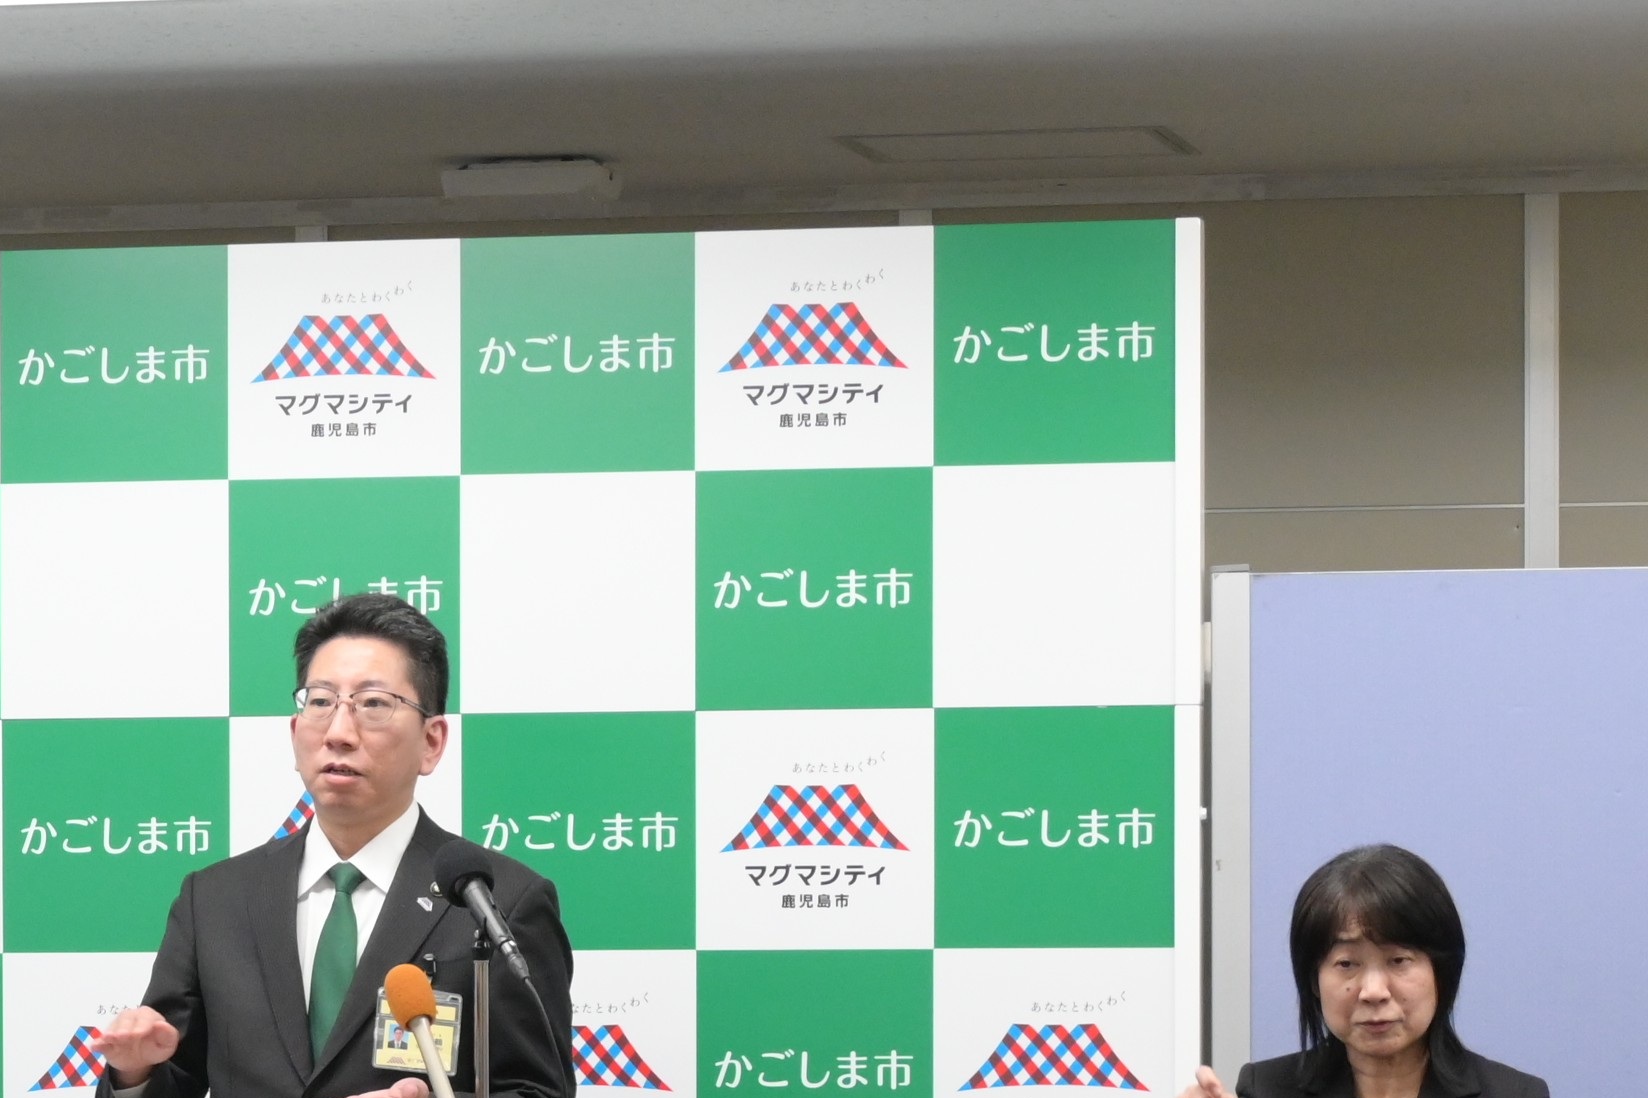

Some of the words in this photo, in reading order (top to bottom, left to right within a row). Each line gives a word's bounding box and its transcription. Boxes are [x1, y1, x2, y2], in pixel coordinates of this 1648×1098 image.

[321, 280, 413, 304] あなたとわくわく
[790, 268, 885, 292] あなたとわくわく
[479, 333, 675, 374] かごしま市
[954, 321, 1155, 363] かごしま市
[19, 344, 209, 385] かごしま市
[276, 394, 411, 415] マグマシティ
[743, 383, 883, 405] マグマシティ
[311, 423, 376, 437] 鹿児島市
[780, 412, 847, 427] 鹿児島市
[714, 568, 913, 608] かごしま市
[792, 751, 887, 774] あなたとわくわく
[21, 816, 211, 855] かごしま市
[483, 812, 678, 851] かごしま市
[954, 808, 1155, 848] かごしま市
[745, 864, 885, 886] マグマシティ
[782, 894, 848, 908] 鹿児島市
[1031, 990, 1127, 1013] あなたとわくわく
[715, 1049, 913, 1089] かごしま市
